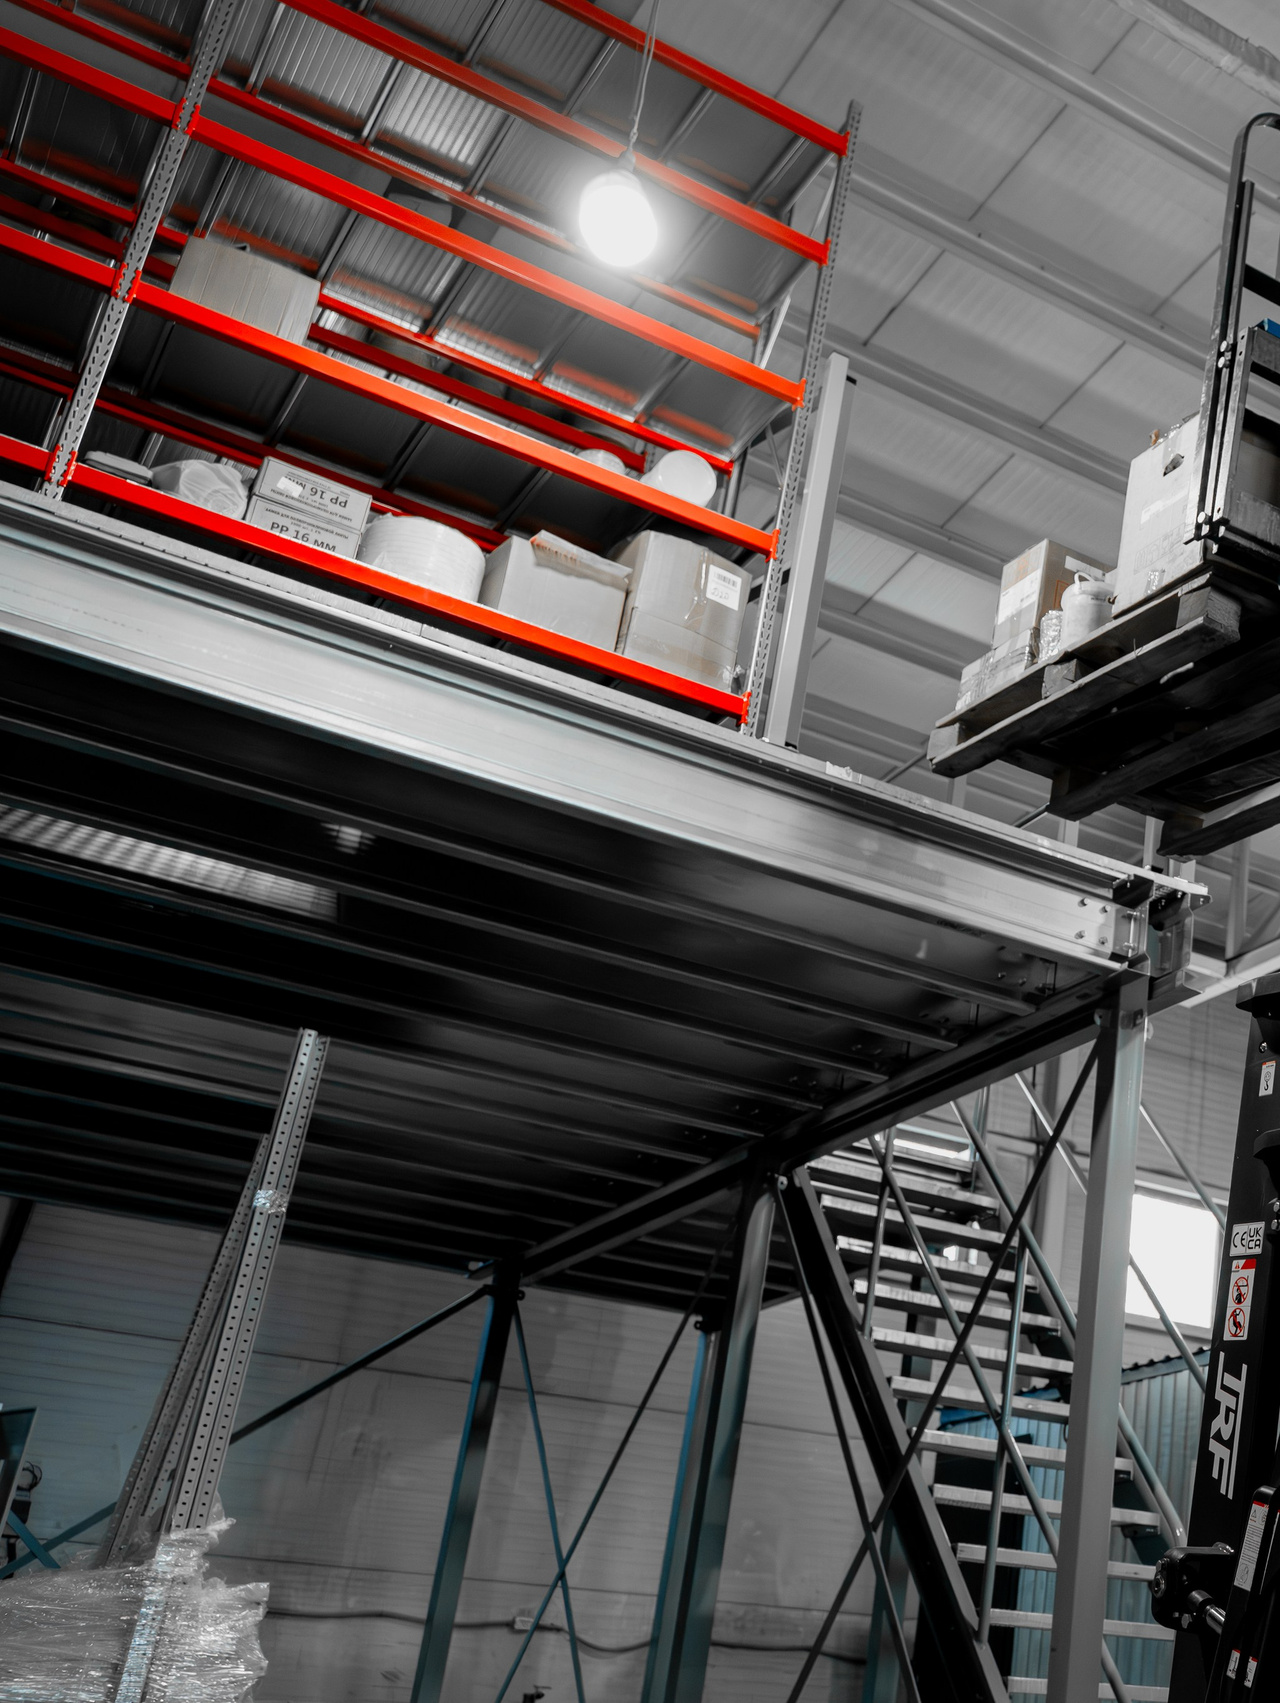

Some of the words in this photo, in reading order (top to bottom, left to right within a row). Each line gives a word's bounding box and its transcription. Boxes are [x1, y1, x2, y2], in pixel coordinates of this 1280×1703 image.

[309, 486, 326, 500] 16
[329, 496, 349, 509] PP
[270, 521, 289, 534] PP
[292, 529, 310, 543] 16
[1248, 1226, 1262, 1238] UK
[1232, 1231, 1247, 1248] CE
[1247, 1239, 1261, 1250] CA
